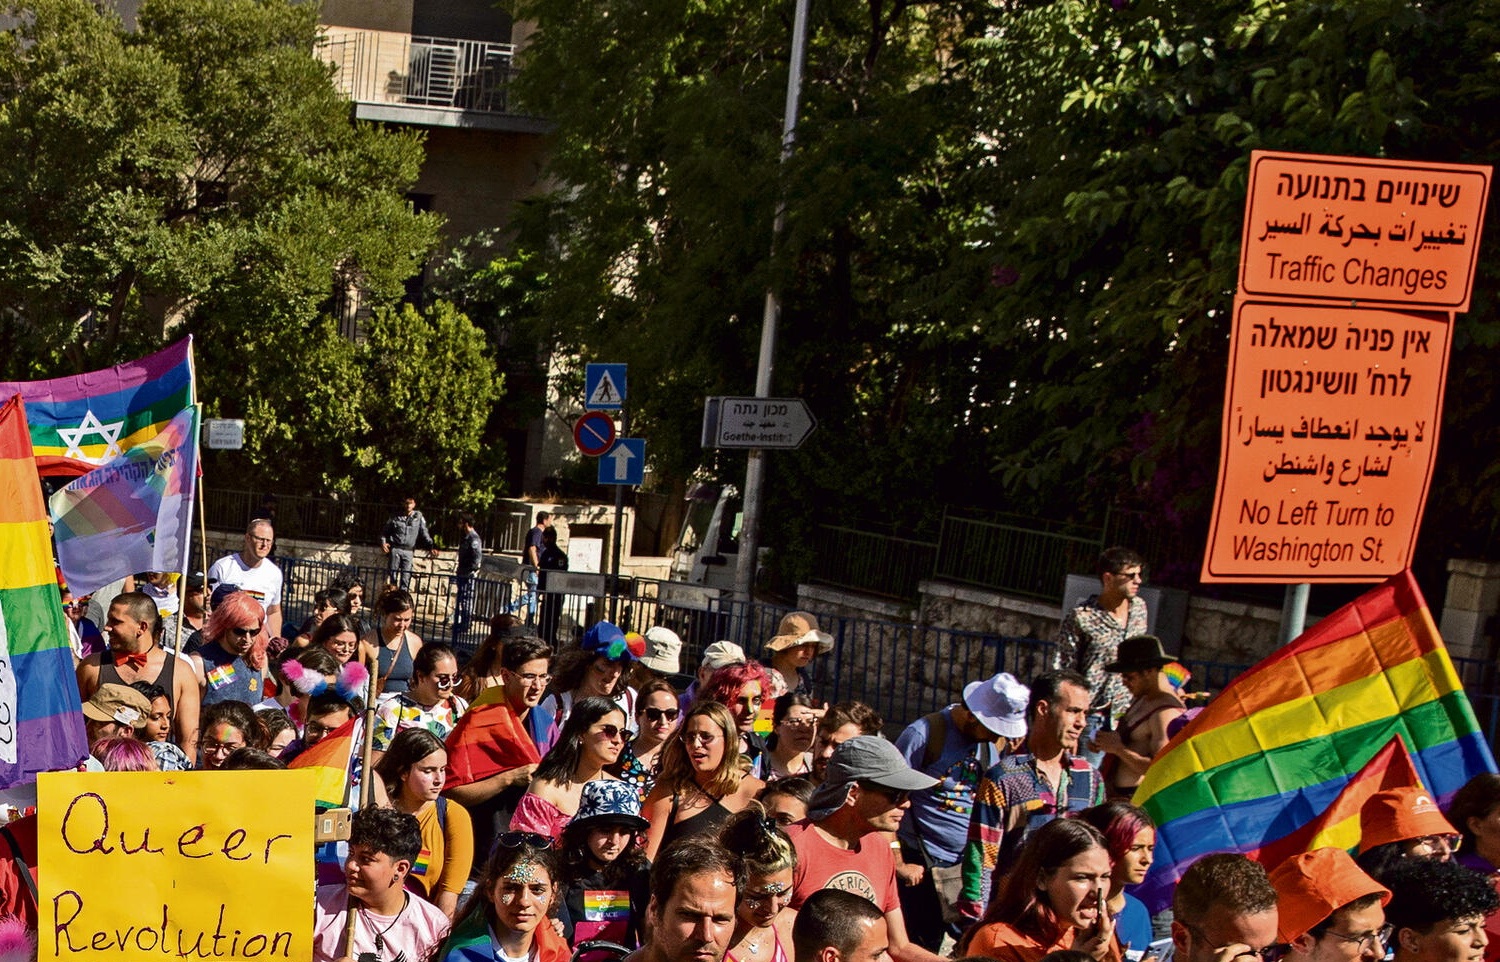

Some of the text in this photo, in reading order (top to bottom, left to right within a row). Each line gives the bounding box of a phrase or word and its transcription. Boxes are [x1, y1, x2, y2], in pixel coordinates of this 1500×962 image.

[1276, 173, 1461, 208] שינויים בתנועה
[1258, 212, 1468, 252] تغييرات بحركة السير
[1266, 252, 1448, 295] Traffic Changes
[1251, 317, 1431, 360] אין פניה שמאלה
[1260, 367, 1412, 399] לרח' וושינגטון
[1290, 416, 1359, 440] انعطاف
[1364, 424, 1409, 451] يوجد
[1414, 420, 1426, 443] لا
[1262, 452, 1392, 487] لشارع واشنطن
[1238, 499, 1395, 527] No Left Turn to
[1232, 535, 1386, 568] Washington St.
[61, 792, 292, 864] Queer
[52, 890, 292, 959] Revolution
